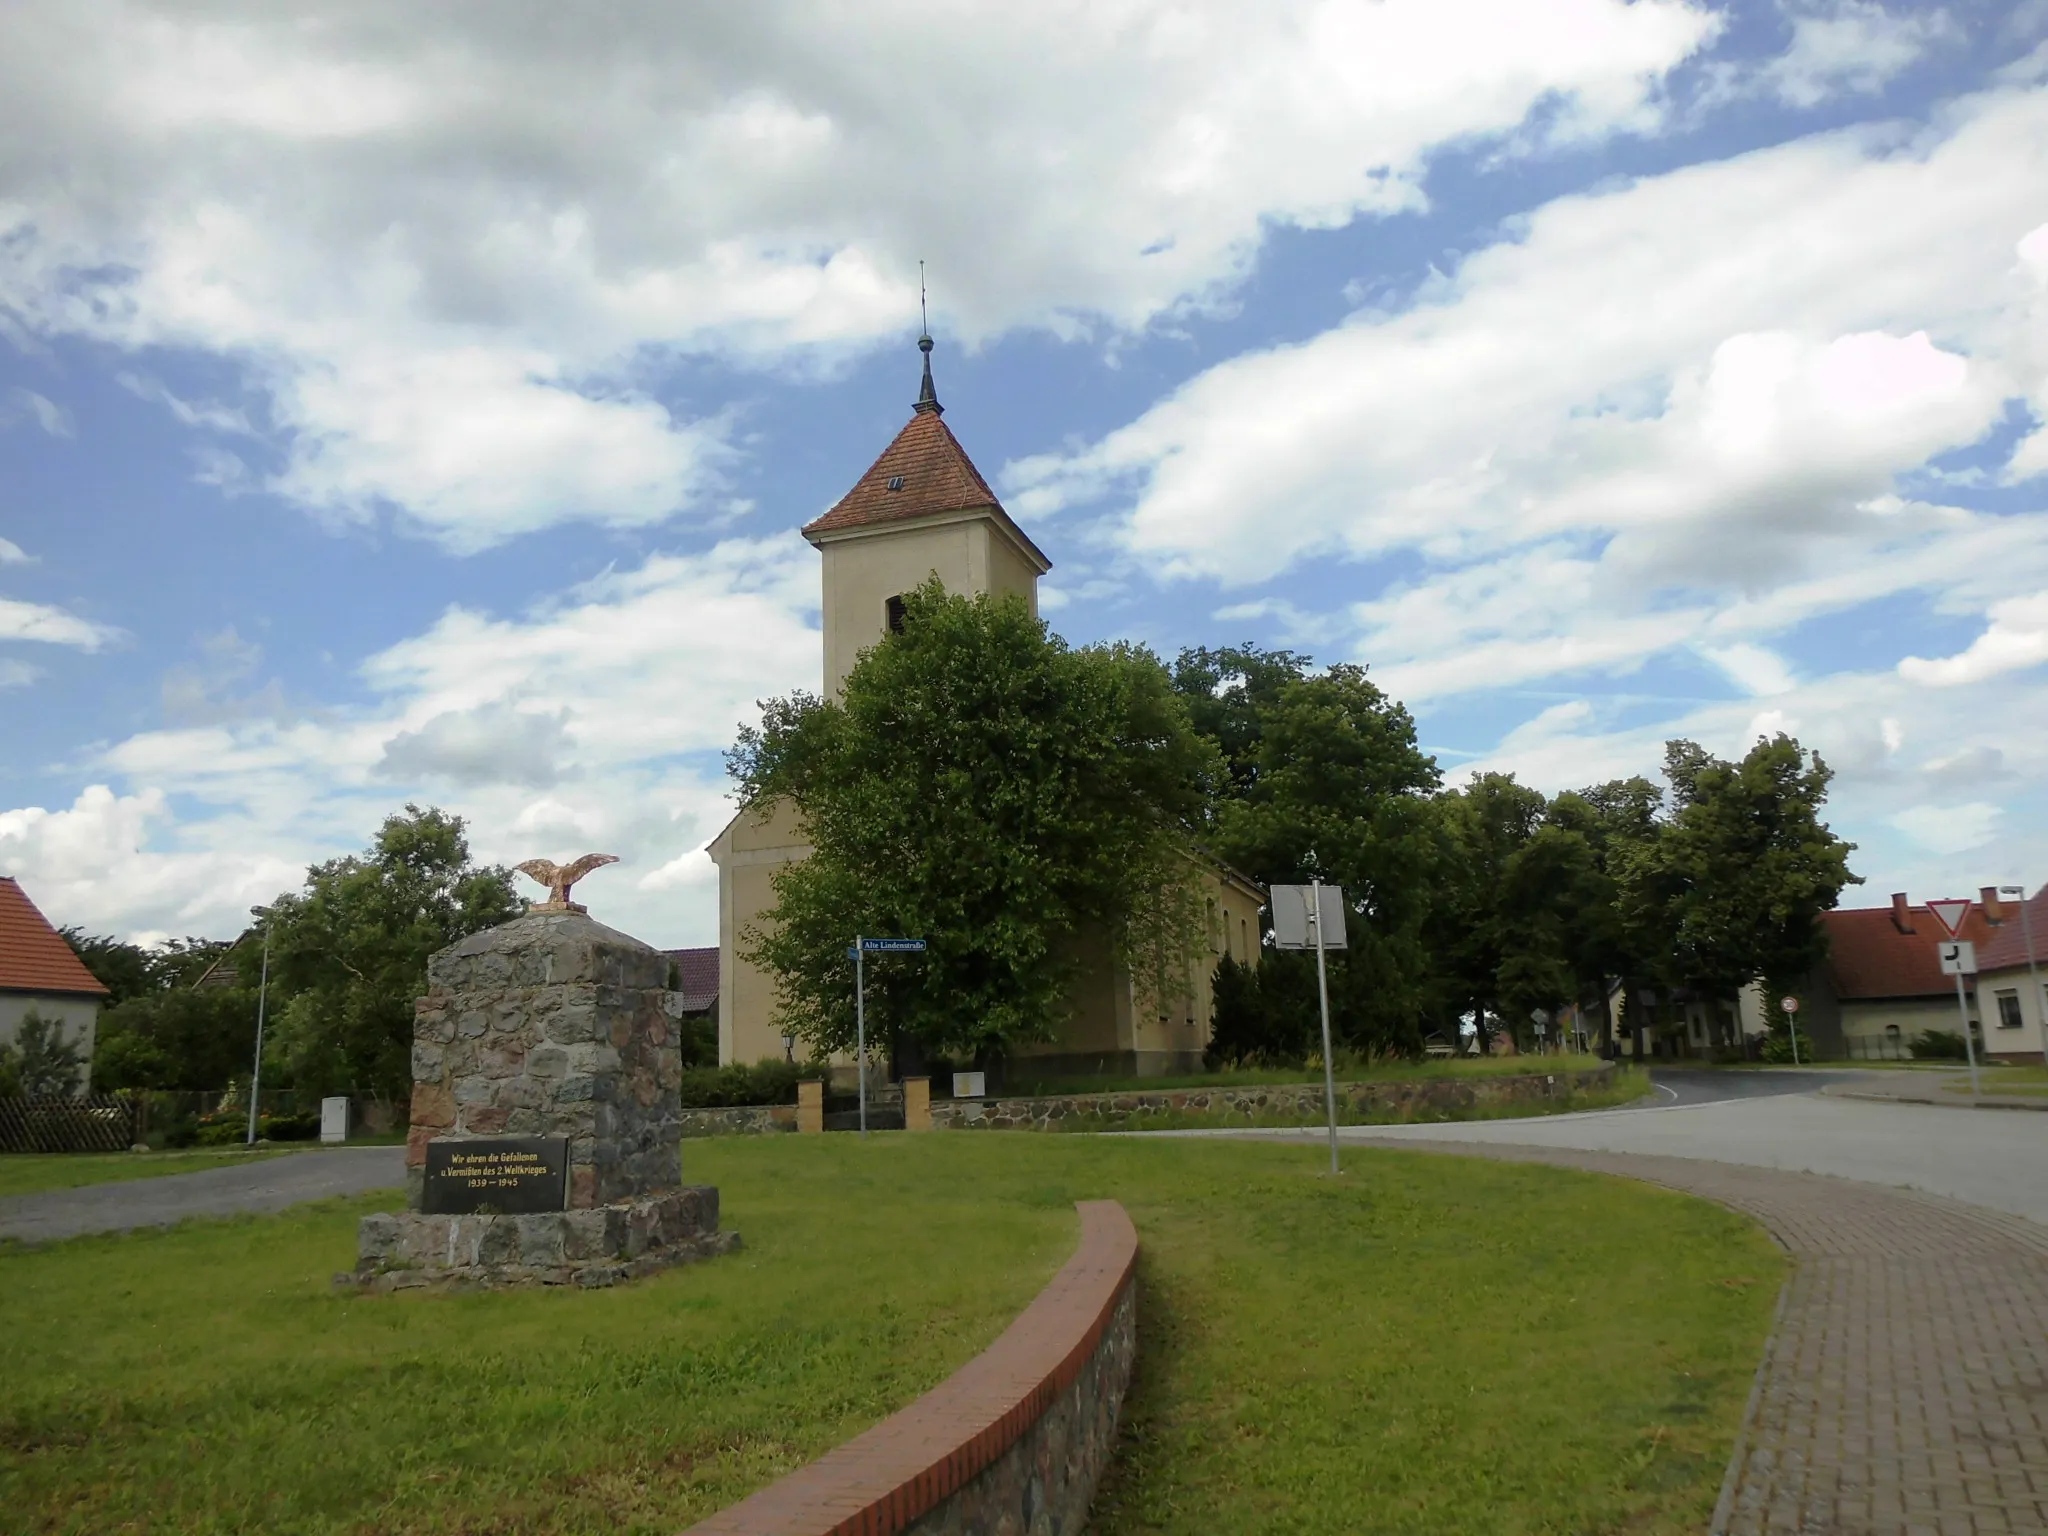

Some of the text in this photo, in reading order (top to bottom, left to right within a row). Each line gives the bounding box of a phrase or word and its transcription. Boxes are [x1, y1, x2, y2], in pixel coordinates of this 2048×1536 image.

[864, 941, 924, 949] Alte Lindenstraße
[452, 1151, 538, 1163] Wir ehren die Gefallenen
[483, 1165, 496, 1175] des
[468, 1178, 487, 1188] 1939
[498, 1177, 518, 1187] 1945
